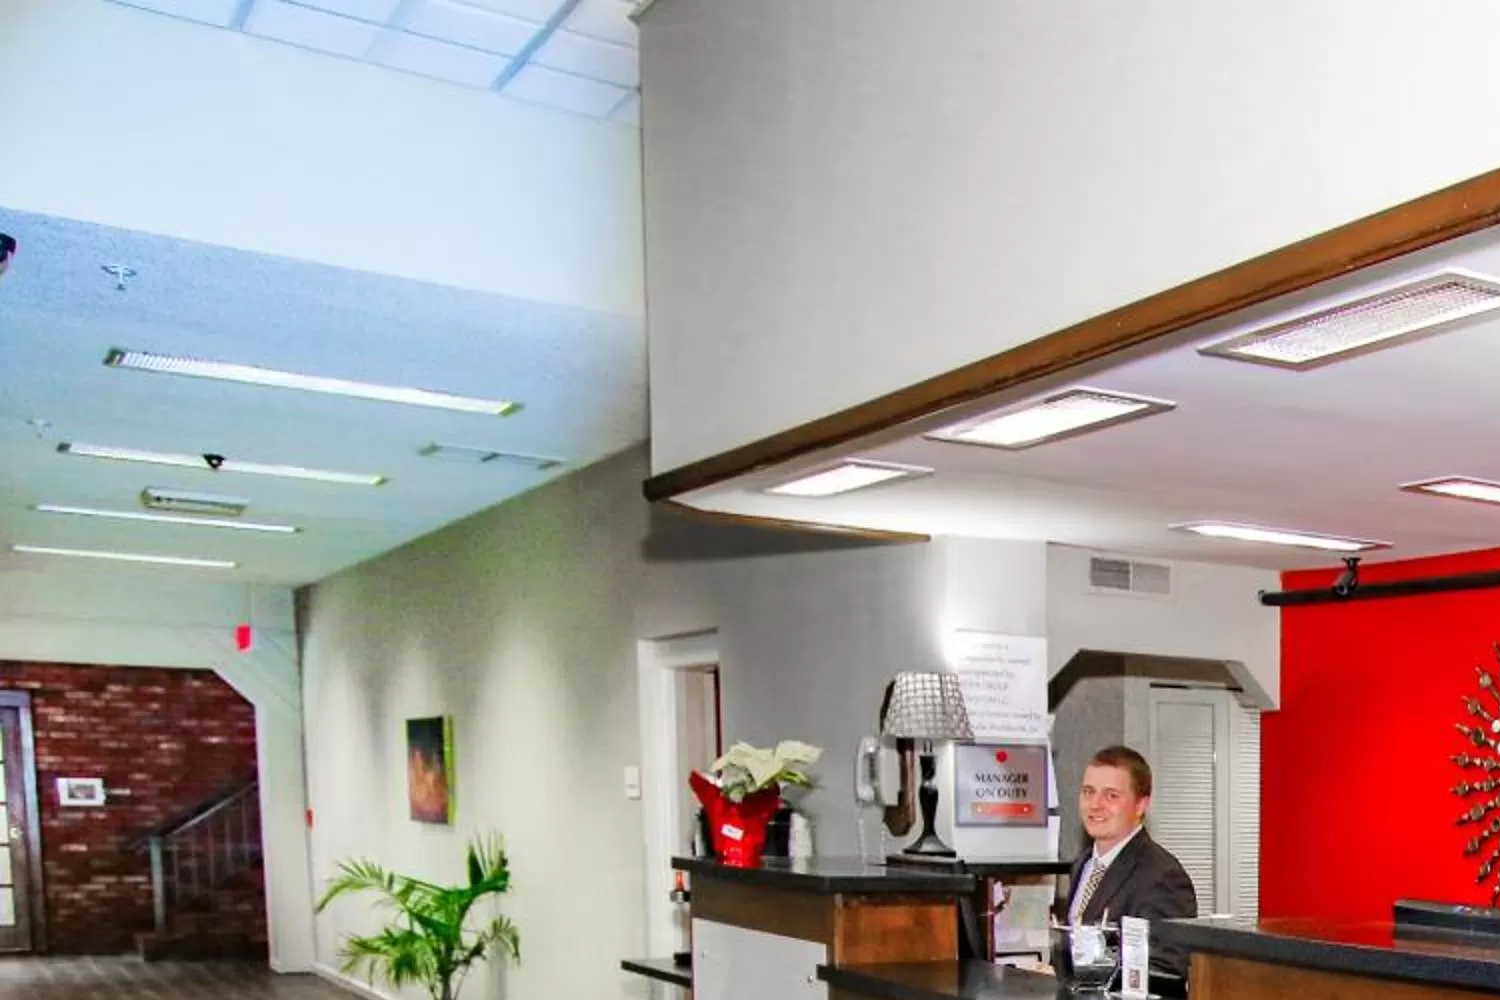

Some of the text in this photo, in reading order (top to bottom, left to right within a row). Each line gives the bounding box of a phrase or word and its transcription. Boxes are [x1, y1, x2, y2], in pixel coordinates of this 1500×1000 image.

[975, 772, 1029, 784] MANAGER
[975, 787, 1028, 798] ON DUTY
